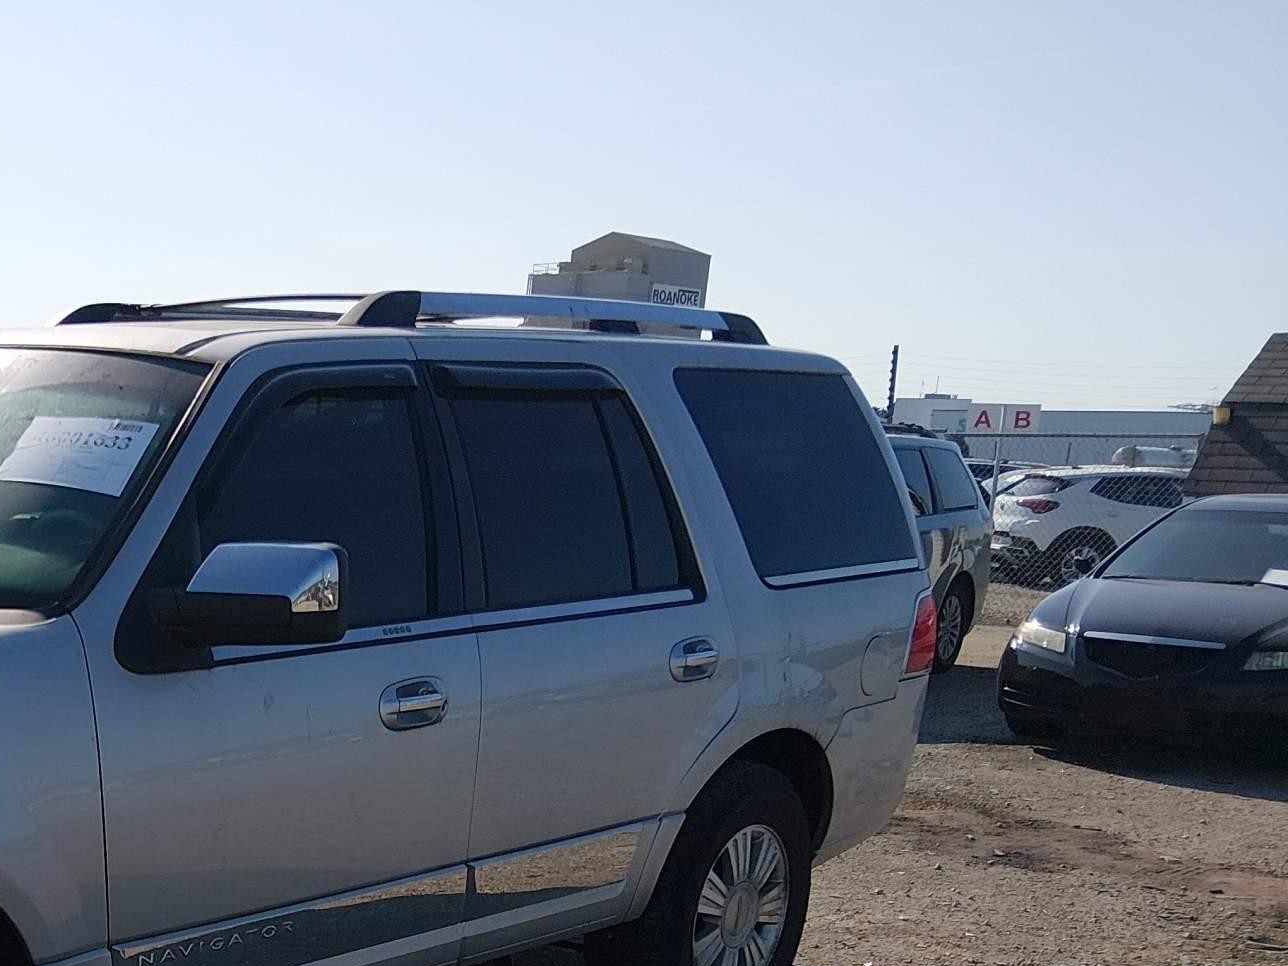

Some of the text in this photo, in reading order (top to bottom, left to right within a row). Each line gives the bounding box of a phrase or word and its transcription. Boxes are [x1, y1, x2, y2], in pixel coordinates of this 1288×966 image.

[653, 289, 699, 305] ROANOKE
[974, 410, 991, 428] A
[1014, 410, 1031, 428] B
